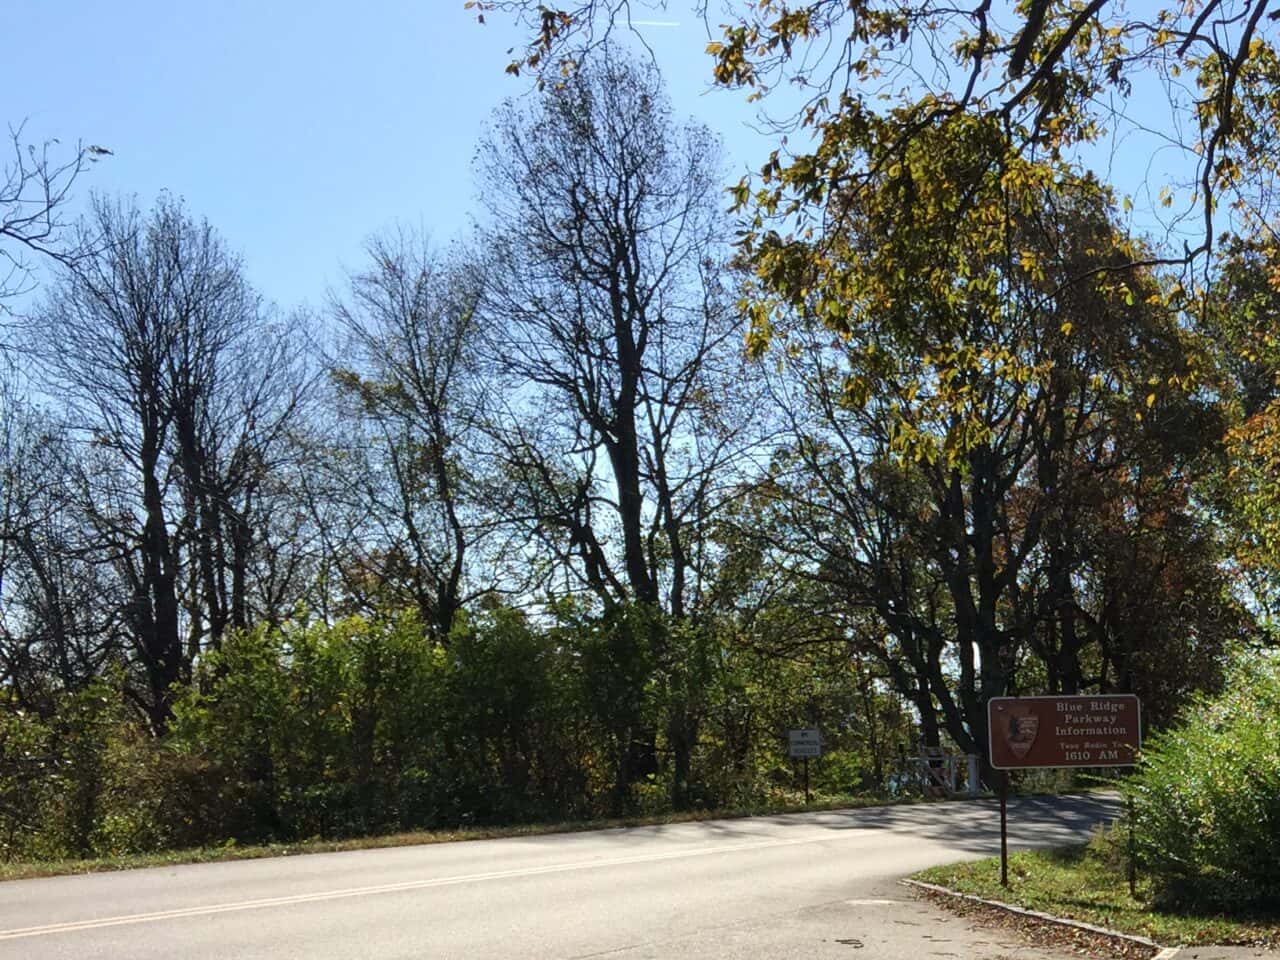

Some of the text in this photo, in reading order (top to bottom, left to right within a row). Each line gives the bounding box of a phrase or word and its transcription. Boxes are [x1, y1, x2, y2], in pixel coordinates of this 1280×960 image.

[1056, 701, 1125, 713] Blue Ridge
[1064, 714, 1117, 725] Parkway
[1055, 726, 1127, 736] Information
[1065, 750, 1119, 761] 1610 AM
